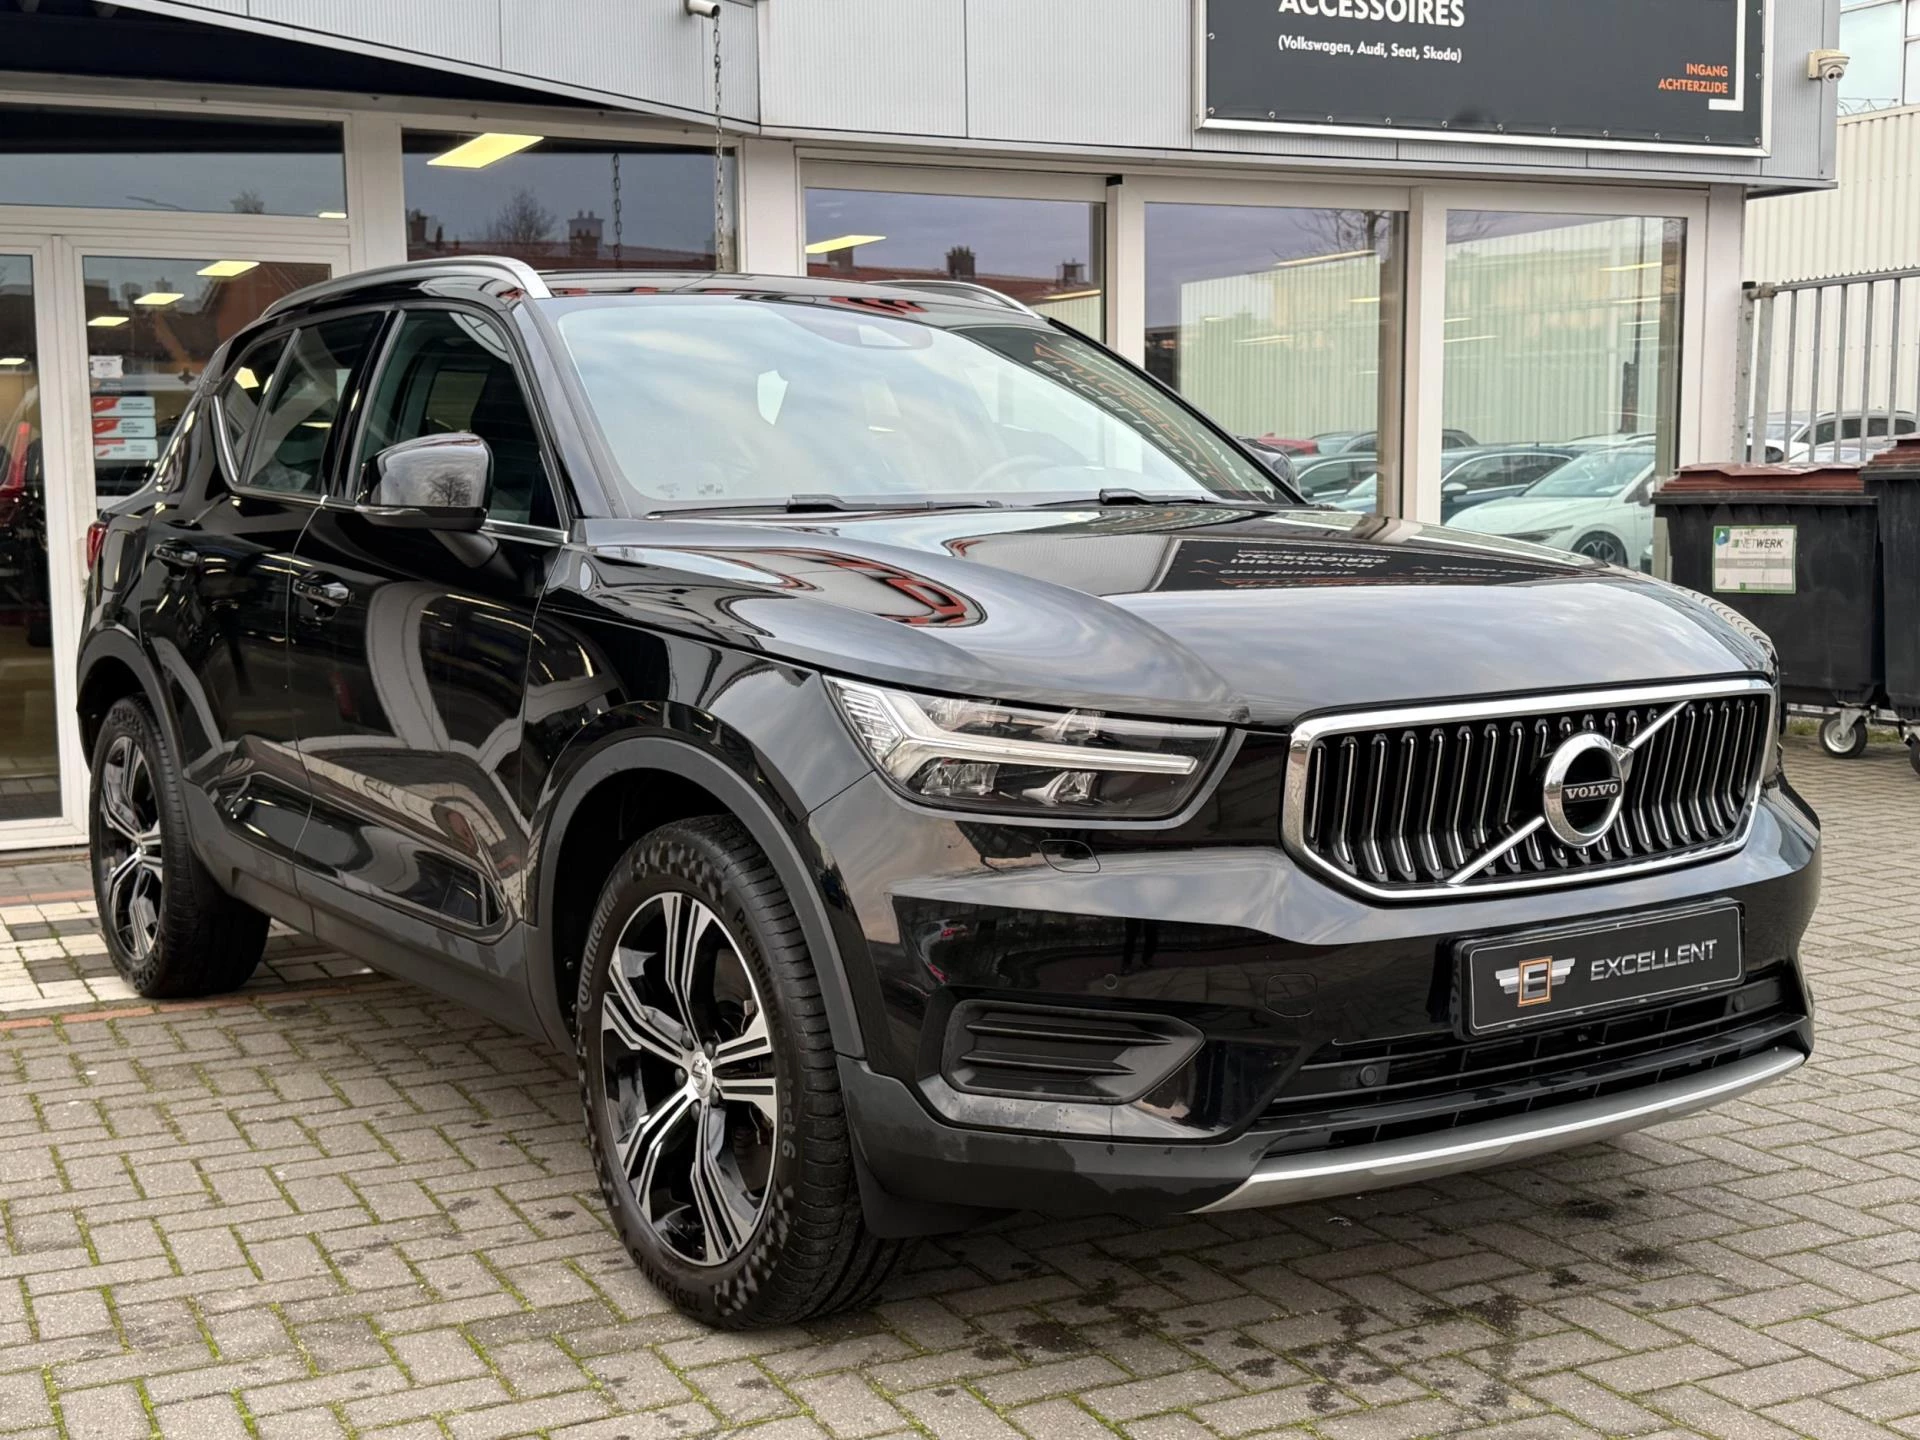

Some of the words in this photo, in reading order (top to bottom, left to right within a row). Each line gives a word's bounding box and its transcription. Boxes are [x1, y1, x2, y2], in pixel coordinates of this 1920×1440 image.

[1278, 35, 1354, 55] (Volkswagen,
[1356, 41, 1388, 58] Audi,
[1391, 43, 1420, 60] Seat,
[1423, 46, 1462, 63] Skoda)
[1686, 63, 1728, 77] INGANG
[1658, 78, 1728, 93] ACHTERZIJDE
[1565, 783, 1619, 799] VOLVO
[1590, 939, 1718, 982] EXCELLENT
